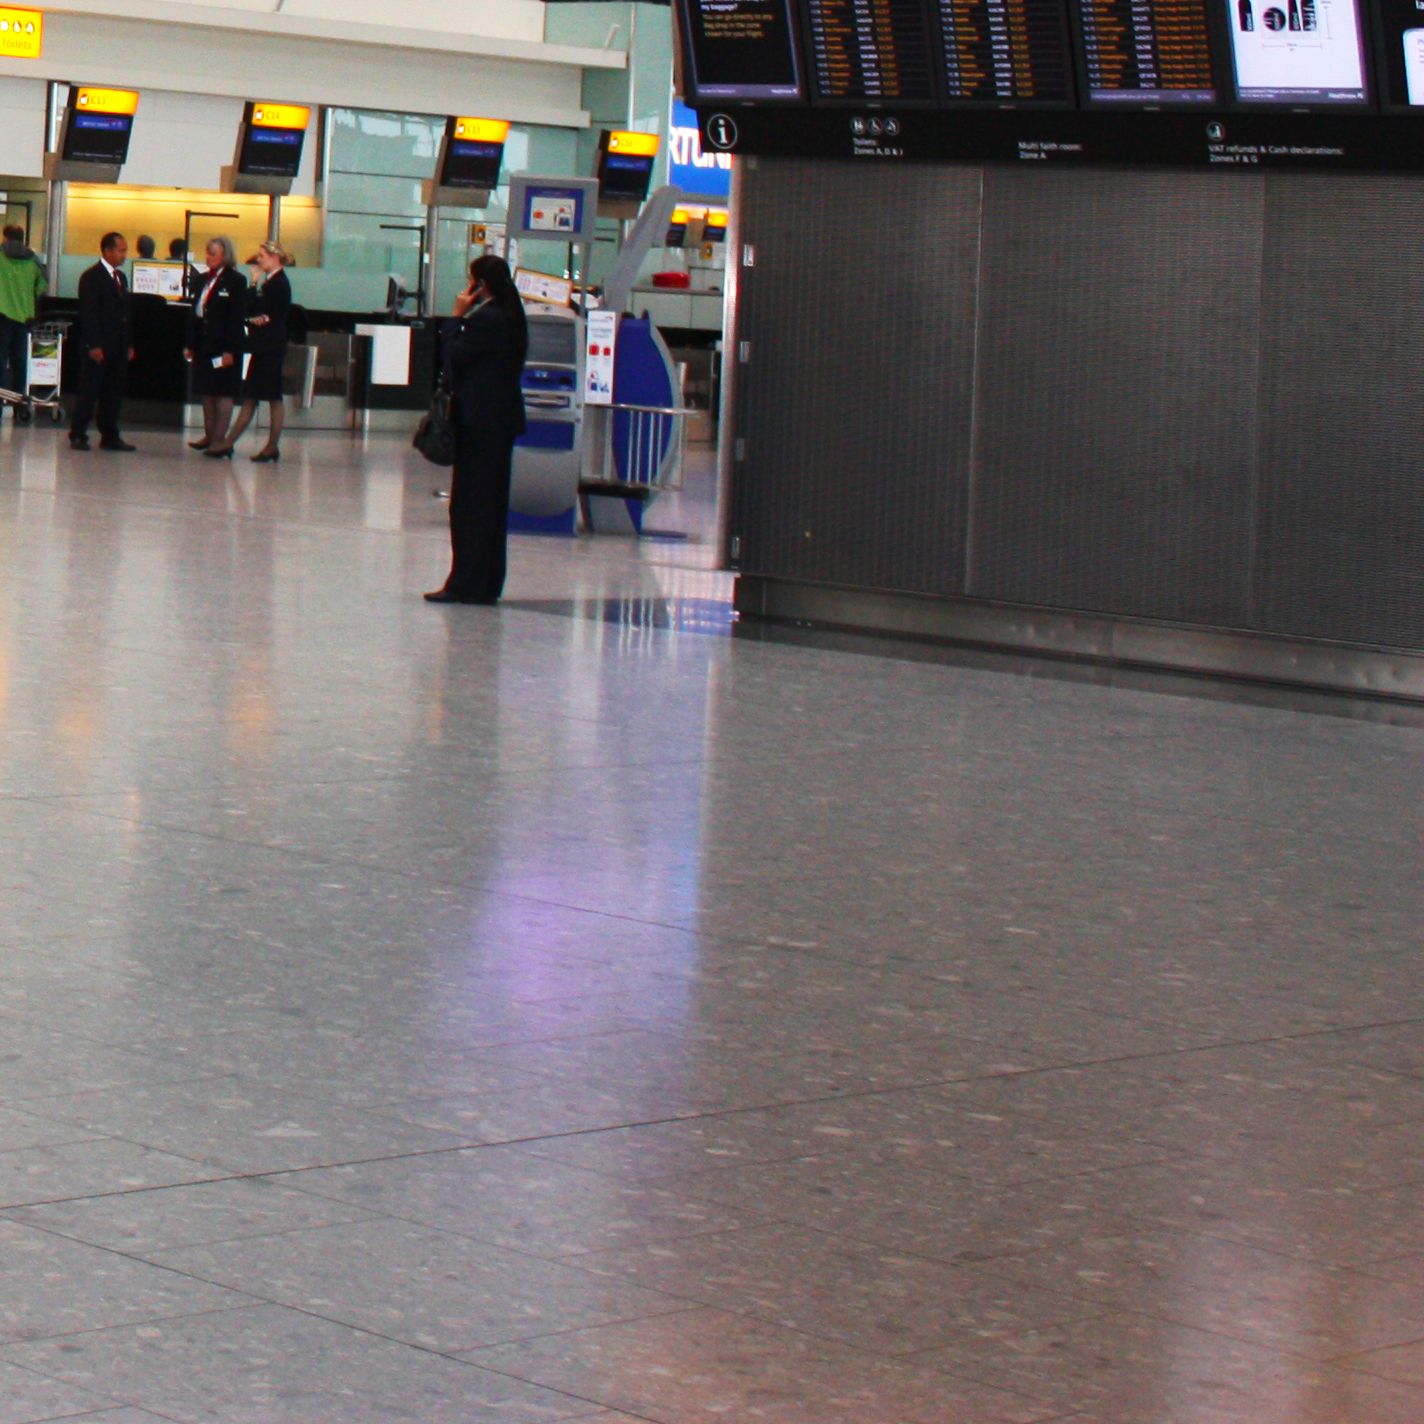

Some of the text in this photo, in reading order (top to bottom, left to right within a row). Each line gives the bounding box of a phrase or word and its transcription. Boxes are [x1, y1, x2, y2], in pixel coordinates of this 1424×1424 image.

[2, 38, 32, 51] Toilets
[1209, 144, 1225, 154] VAT
[1226, 144, 1258, 154] refunds
[1260, 145, 1267, 154] &
[1268, 146, 1289, 155] Cash
[1210, 154, 1234, 163] Zones
